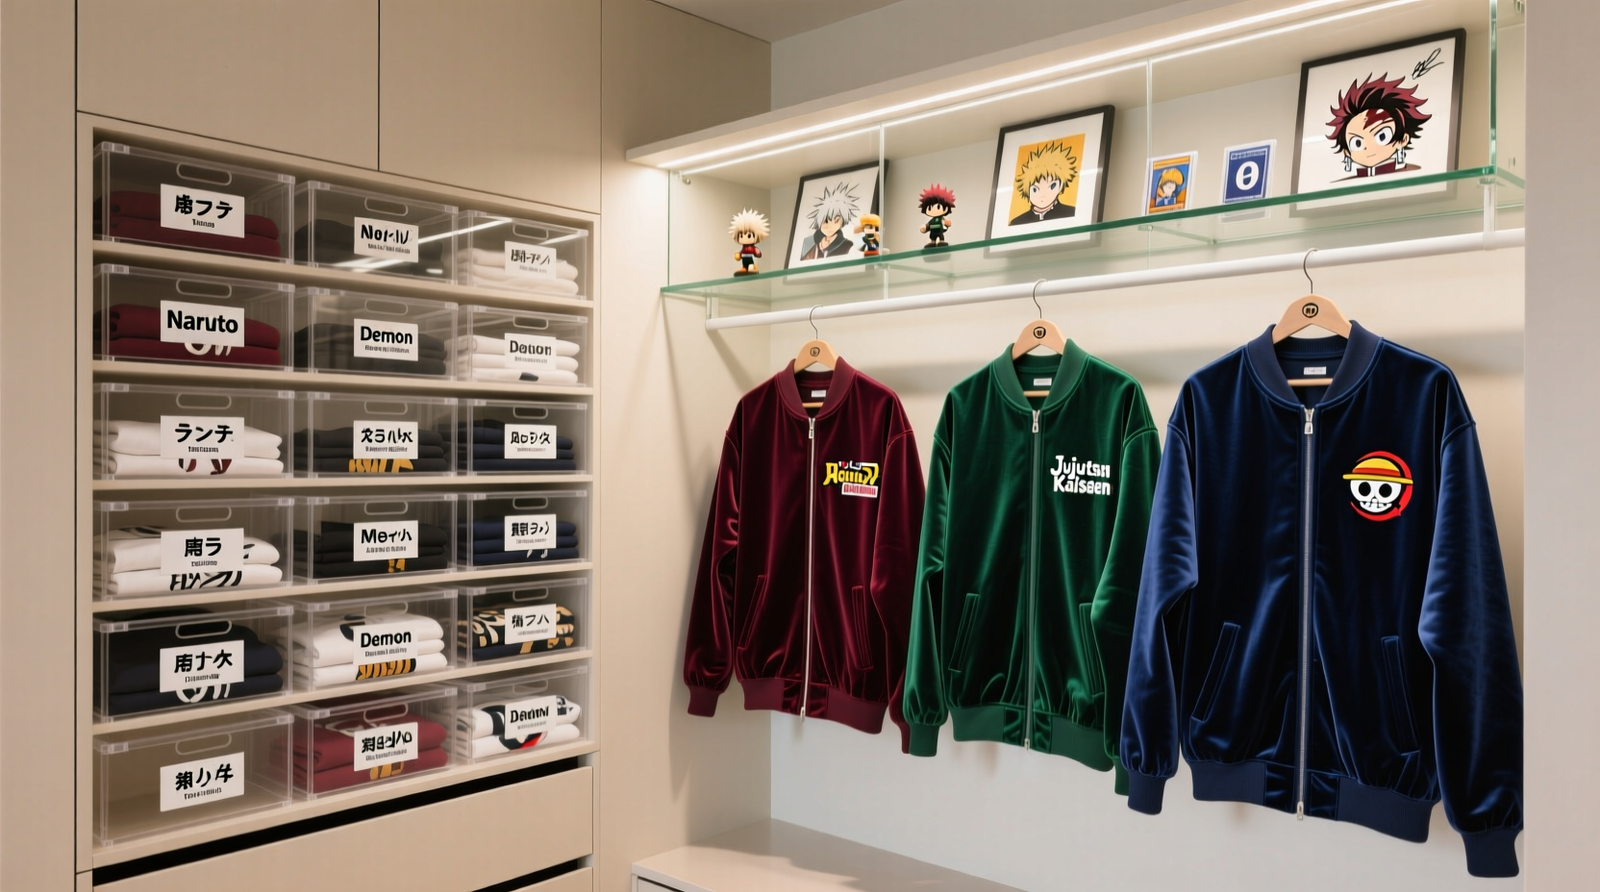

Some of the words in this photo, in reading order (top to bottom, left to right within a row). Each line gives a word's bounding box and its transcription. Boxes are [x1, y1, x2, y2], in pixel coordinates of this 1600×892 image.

[167, 309, 239, 336] Naruto
[360, 326, 413, 346] Demon
[174, 423, 233, 443] ランチ
[360, 631, 412, 649] Demon
